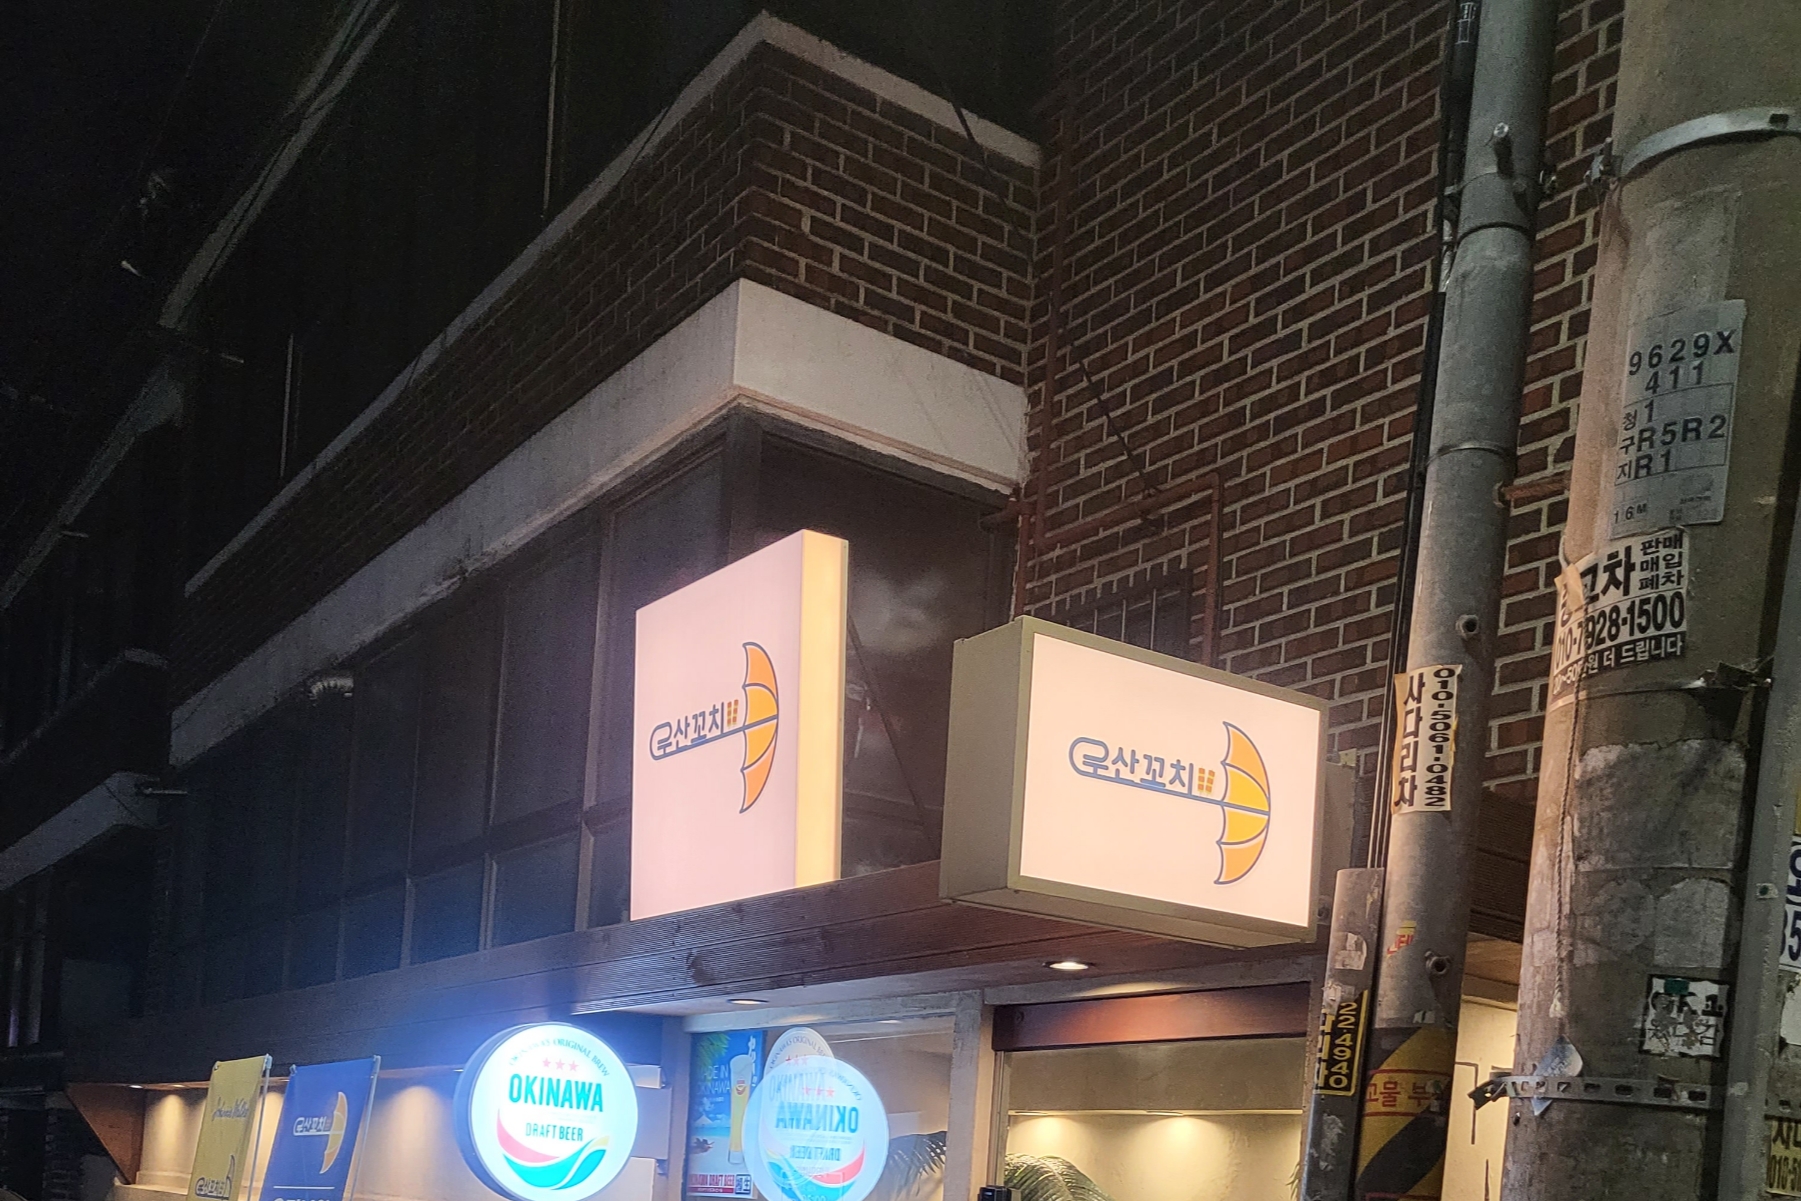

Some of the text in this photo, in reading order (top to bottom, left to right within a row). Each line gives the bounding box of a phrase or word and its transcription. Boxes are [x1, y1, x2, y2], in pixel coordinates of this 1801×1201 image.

[1629, 329, 1737, 376] 9629X
[1645, 361, 1705, 395] 411
[1640, 529, 1684, 556] 판매
[1640, 551, 1684, 573] 매입
[1638, 570, 1685, 591] 폐차
[1603, 649, 1615, 668] 더
[1619, 634, 1683, 663] 드립니다
[1394, 672, 1426, 807] 사다리차
[553, 1038, 592, 1059] ORIGINAL
[591, 1055, 610, 1077] BREW
[508, 1073, 604, 1113] OKINAWA
[525, 1122, 584, 1142] DRAFT BEER
